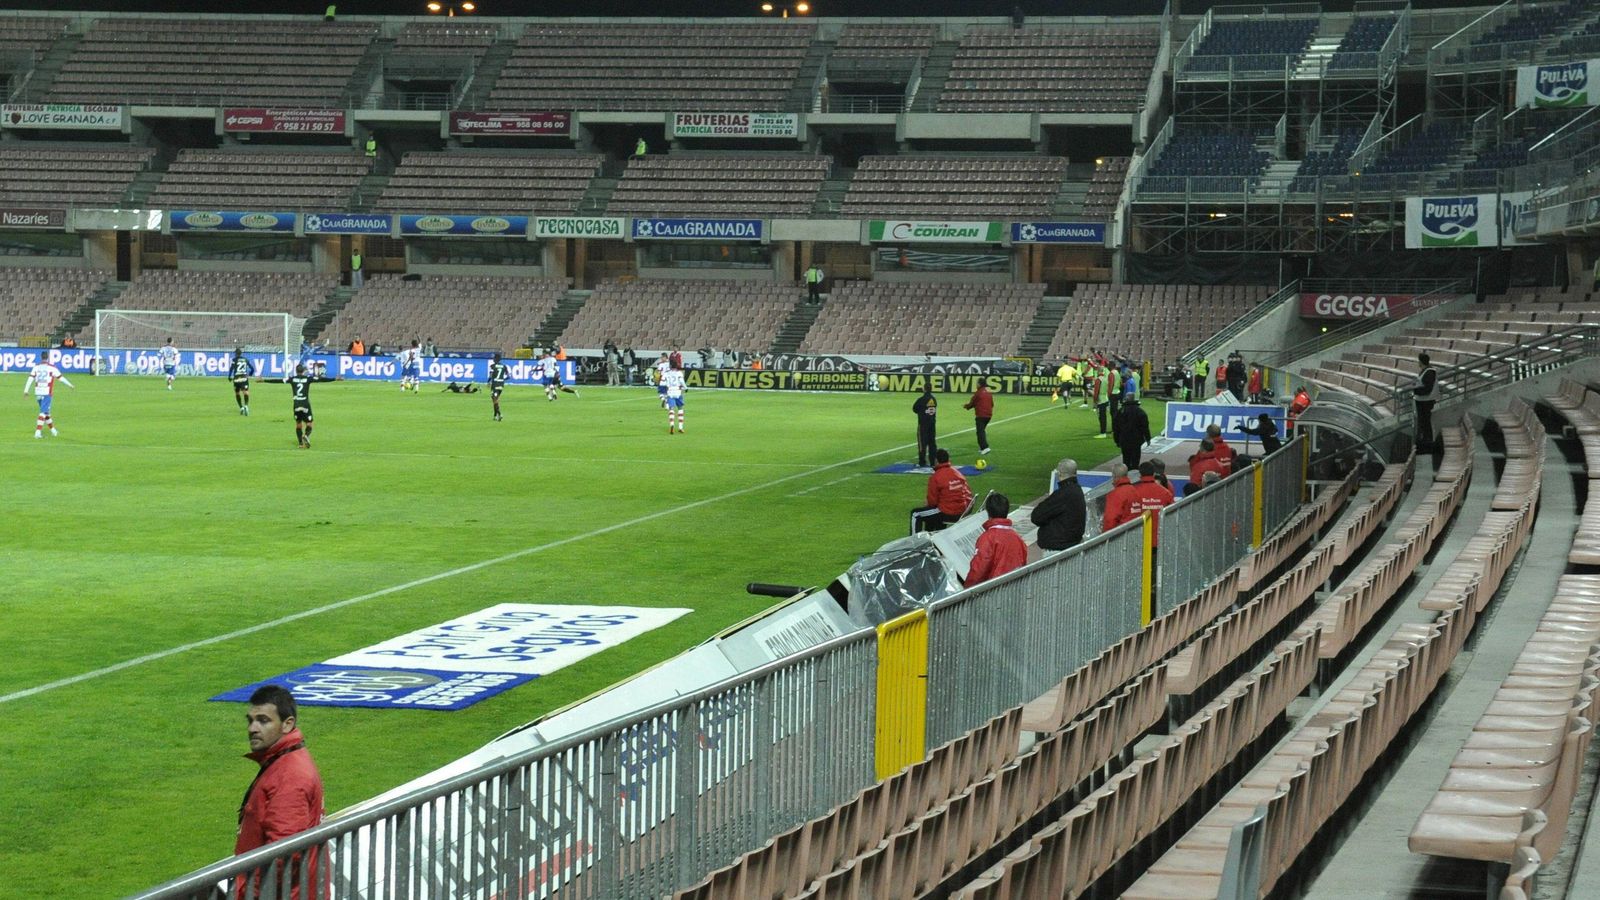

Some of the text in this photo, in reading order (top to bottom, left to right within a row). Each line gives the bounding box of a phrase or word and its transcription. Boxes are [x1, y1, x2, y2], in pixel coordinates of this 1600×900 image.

[1540, 68, 1584, 83] PULEVA
[3, 104, 44, 112] FRUTERIAS
[83, 105, 118, 113] ESCOBAR
[23, 114, 50, 123] LOVE
[53, 114, 104, 124] GRANADA
[676, 114, 750, 126] FRUTERIAS
[283, 122, 335, 131] 958 21 50 57
[676, 126, 712, 134] PATRICIA
[713, 126, 749, 134] ESCOBAR
[1425, 203, 1475, 218] PULEVA
[2, 212, 49, 225] Nazaríes
[538, 219, 620, 235] TECNOCASA
[126, 351, 181, 371] Lóp
[194, 352, 234, 373] Ped
[236, 361, 247, 372] 23
[340, 355, 475, 383] Pedro López
[37, 371, 48, 382] 22
[686, 370, 791, 389] AE WEST
[801, 373, 865, 383] BRIBONES
[296, 383, 304, 396] 2
[888, 374, 944, 393] MAE
[1173, 411, 1275, 434] PULEV
[442, 614, 639, 662] Seguros
